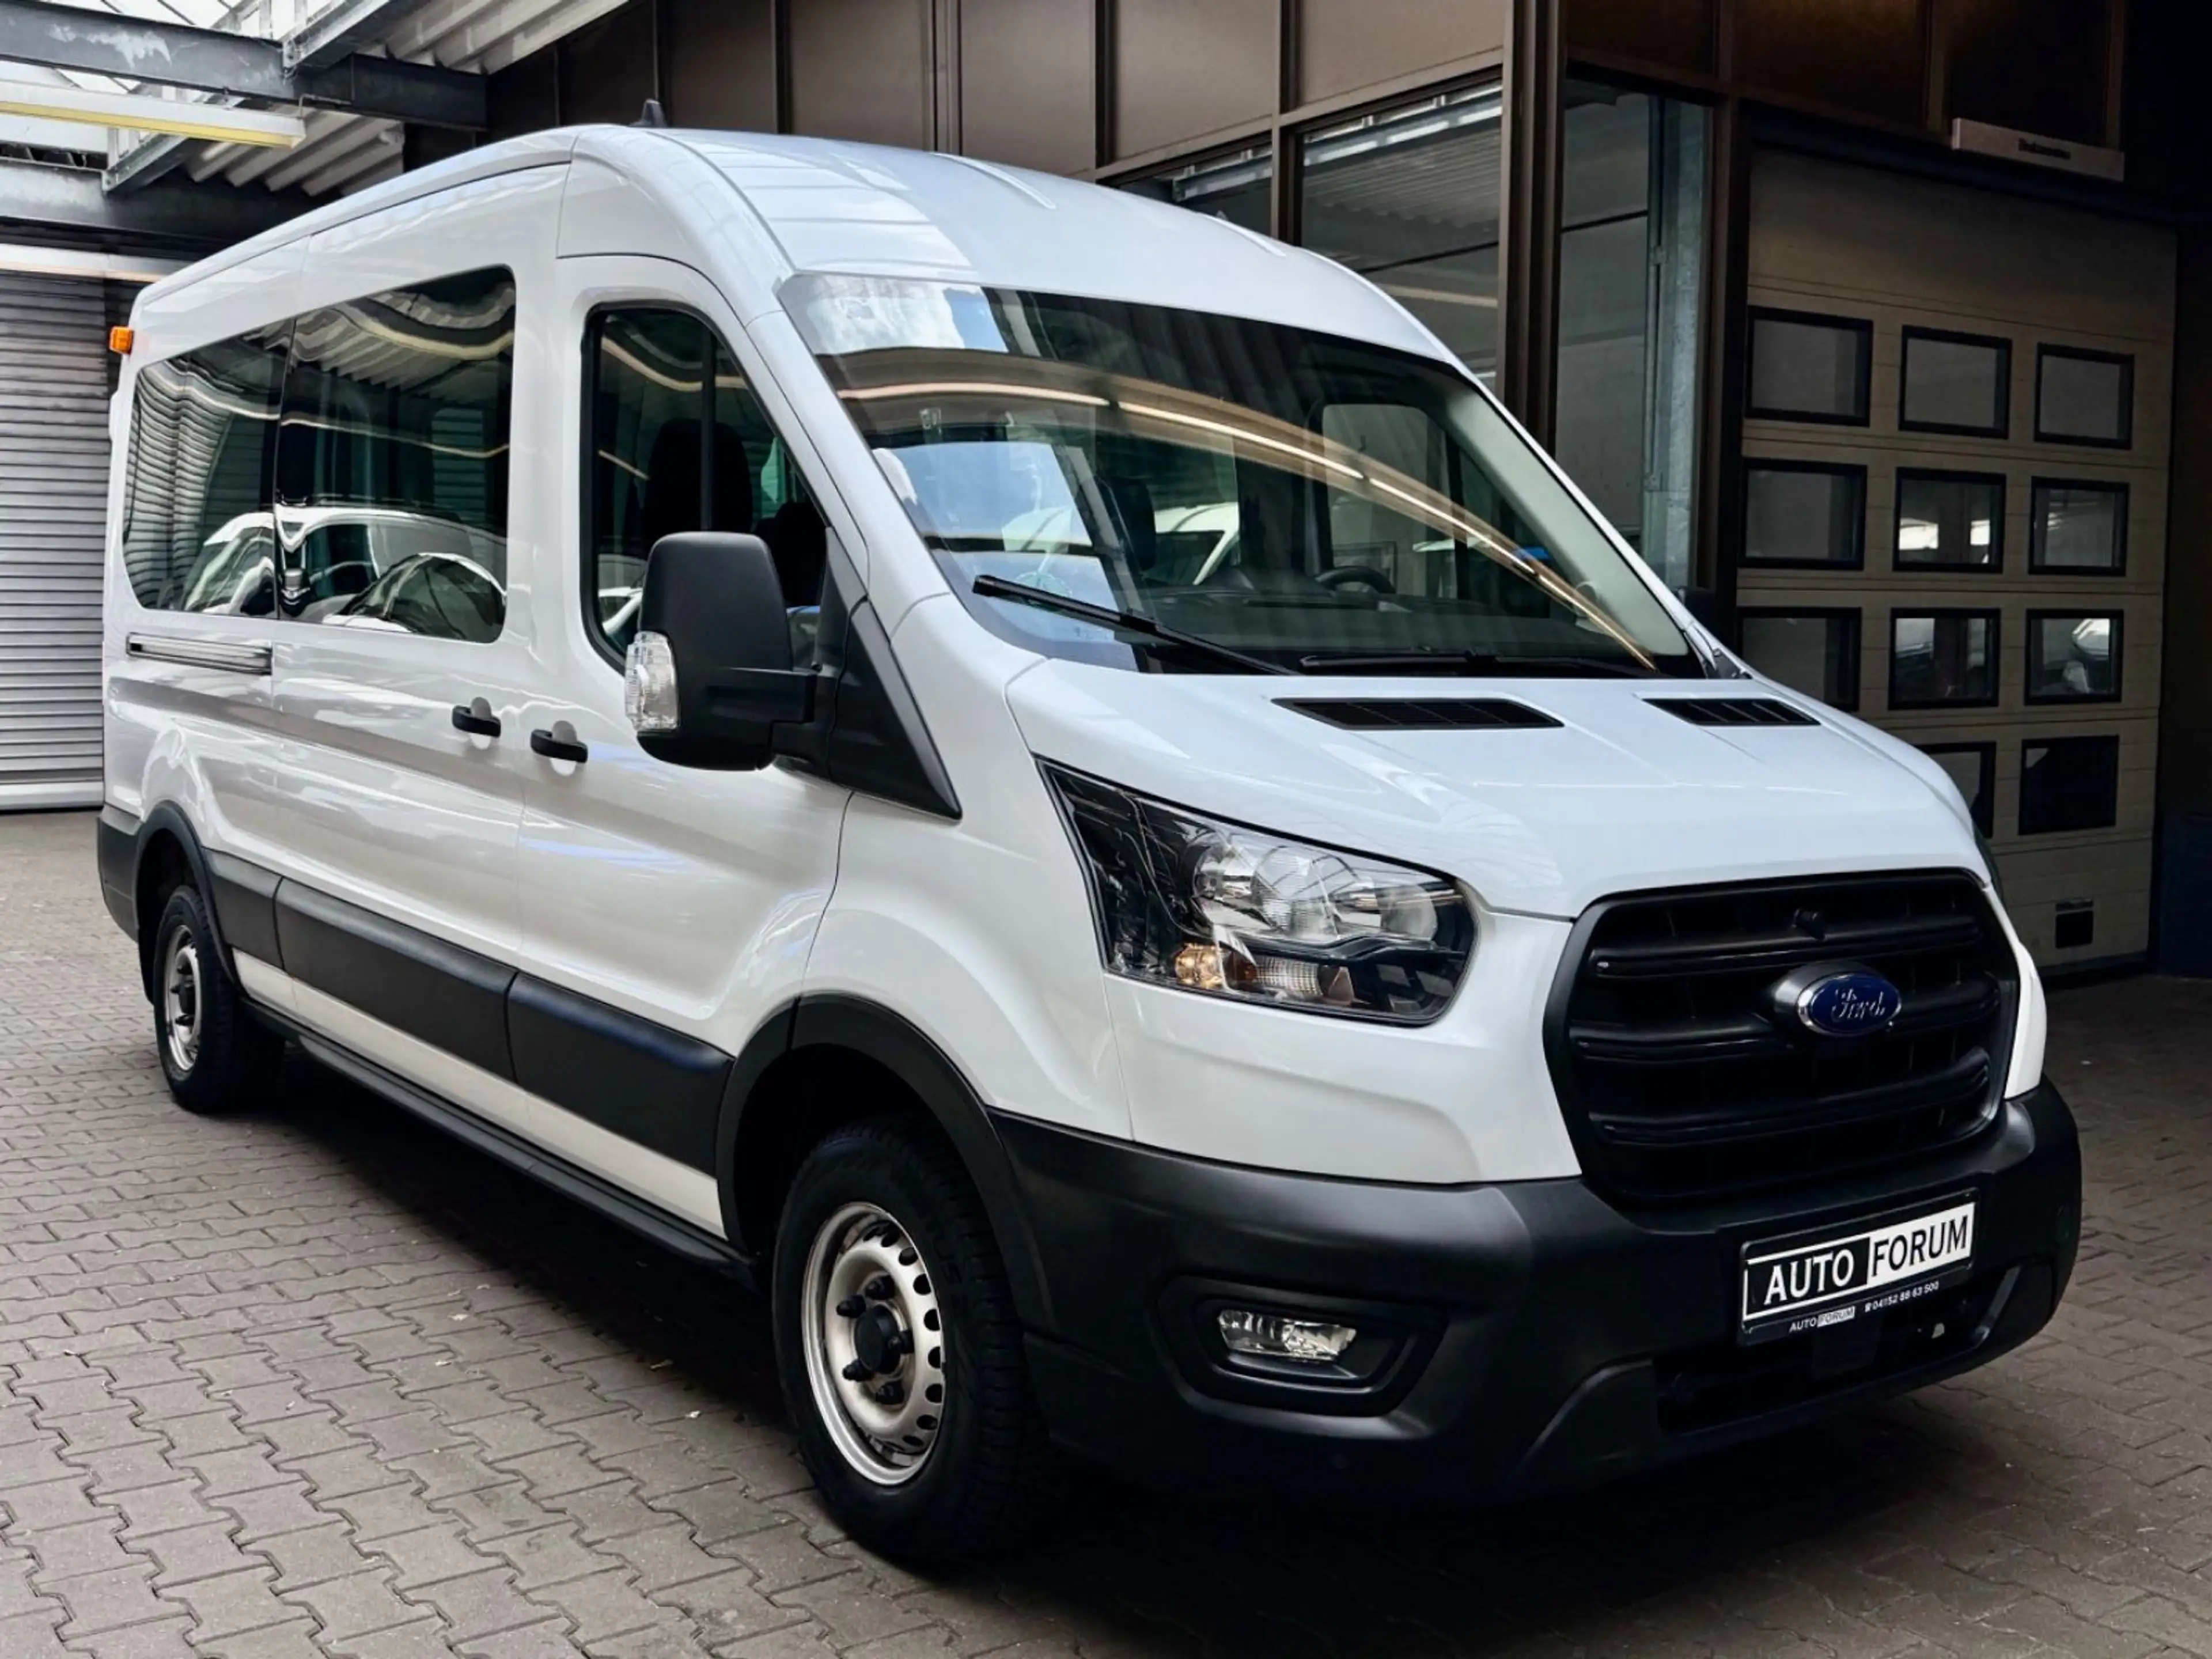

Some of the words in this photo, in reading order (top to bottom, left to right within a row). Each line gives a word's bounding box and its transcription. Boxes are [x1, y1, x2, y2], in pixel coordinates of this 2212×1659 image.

[1831, 988, 1886, 1023] Ford
[1764, 1249, 1854, 1305] AUTO
[1871, 1215, 1968, 1277] FORUM
